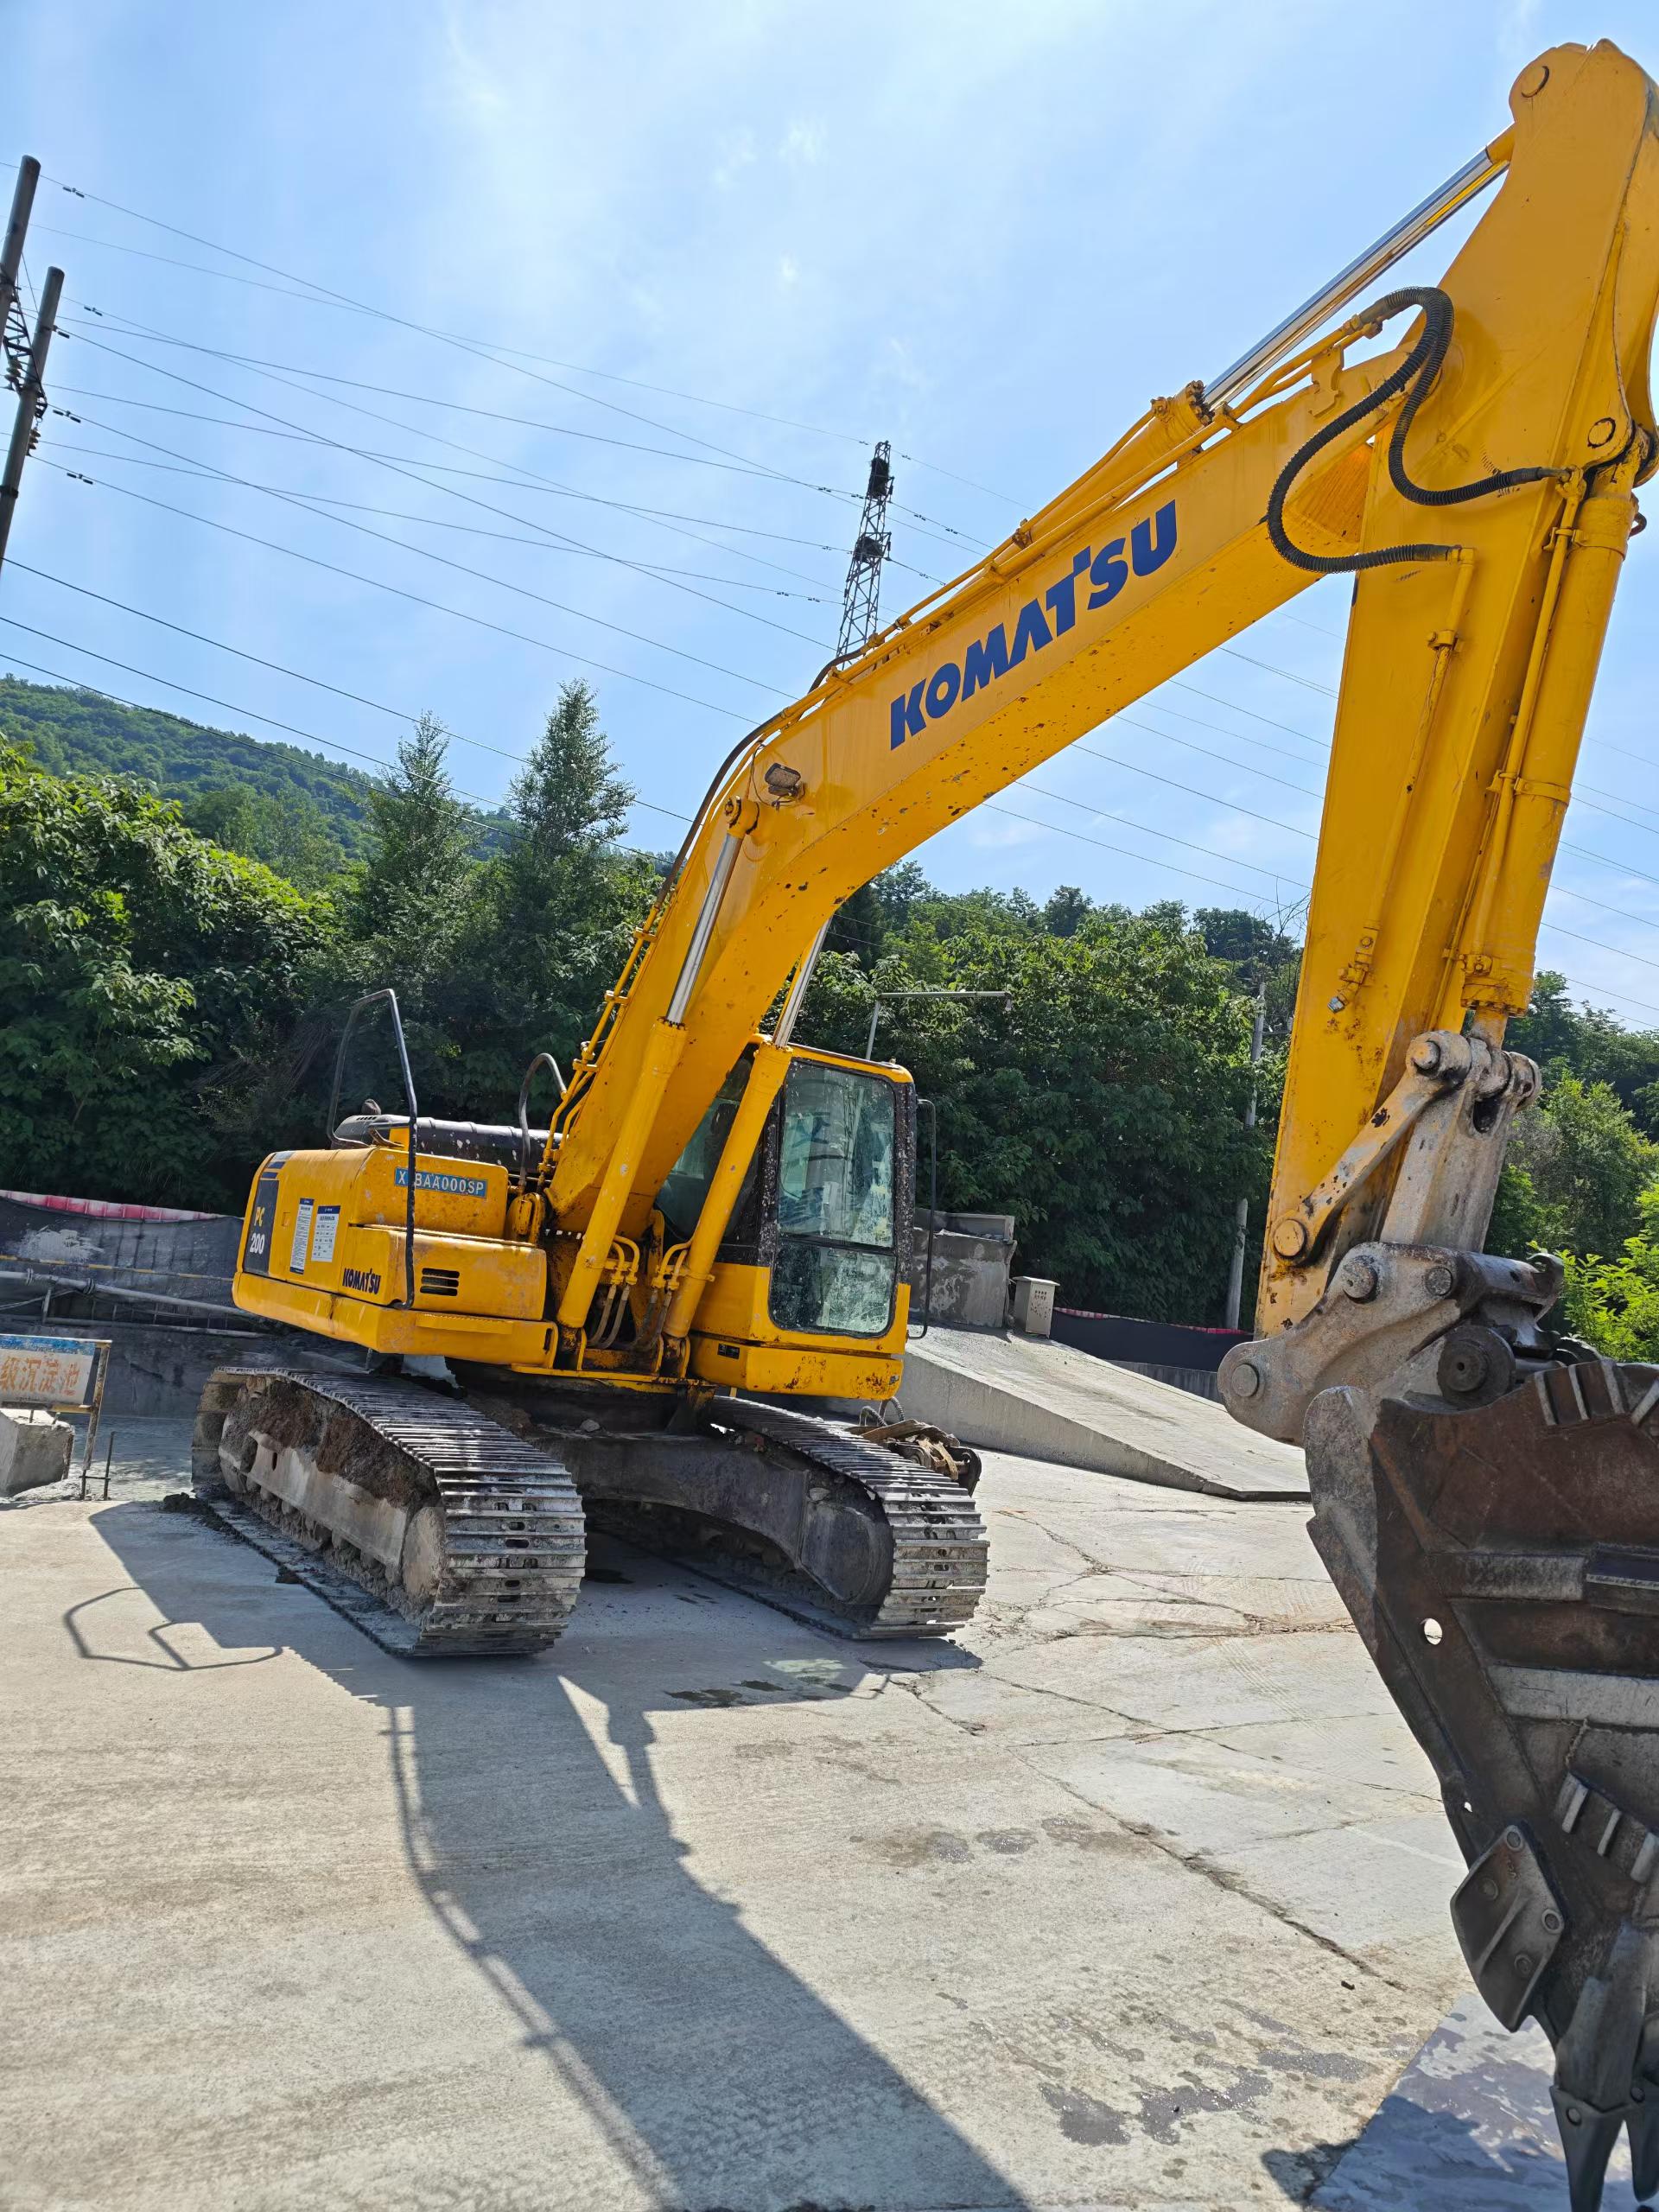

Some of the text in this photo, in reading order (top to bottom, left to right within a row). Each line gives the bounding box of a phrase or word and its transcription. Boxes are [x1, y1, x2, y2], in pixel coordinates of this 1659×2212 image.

[891, 499, 1178, 750] KOMATSU
[398, 1170, 484, 1194] XBAA000SP
[254, 1206, 265, 1227] PC
[250, 1232, 265, 1254] 200
[342, 1268, 381, 1294] KOMATSU
